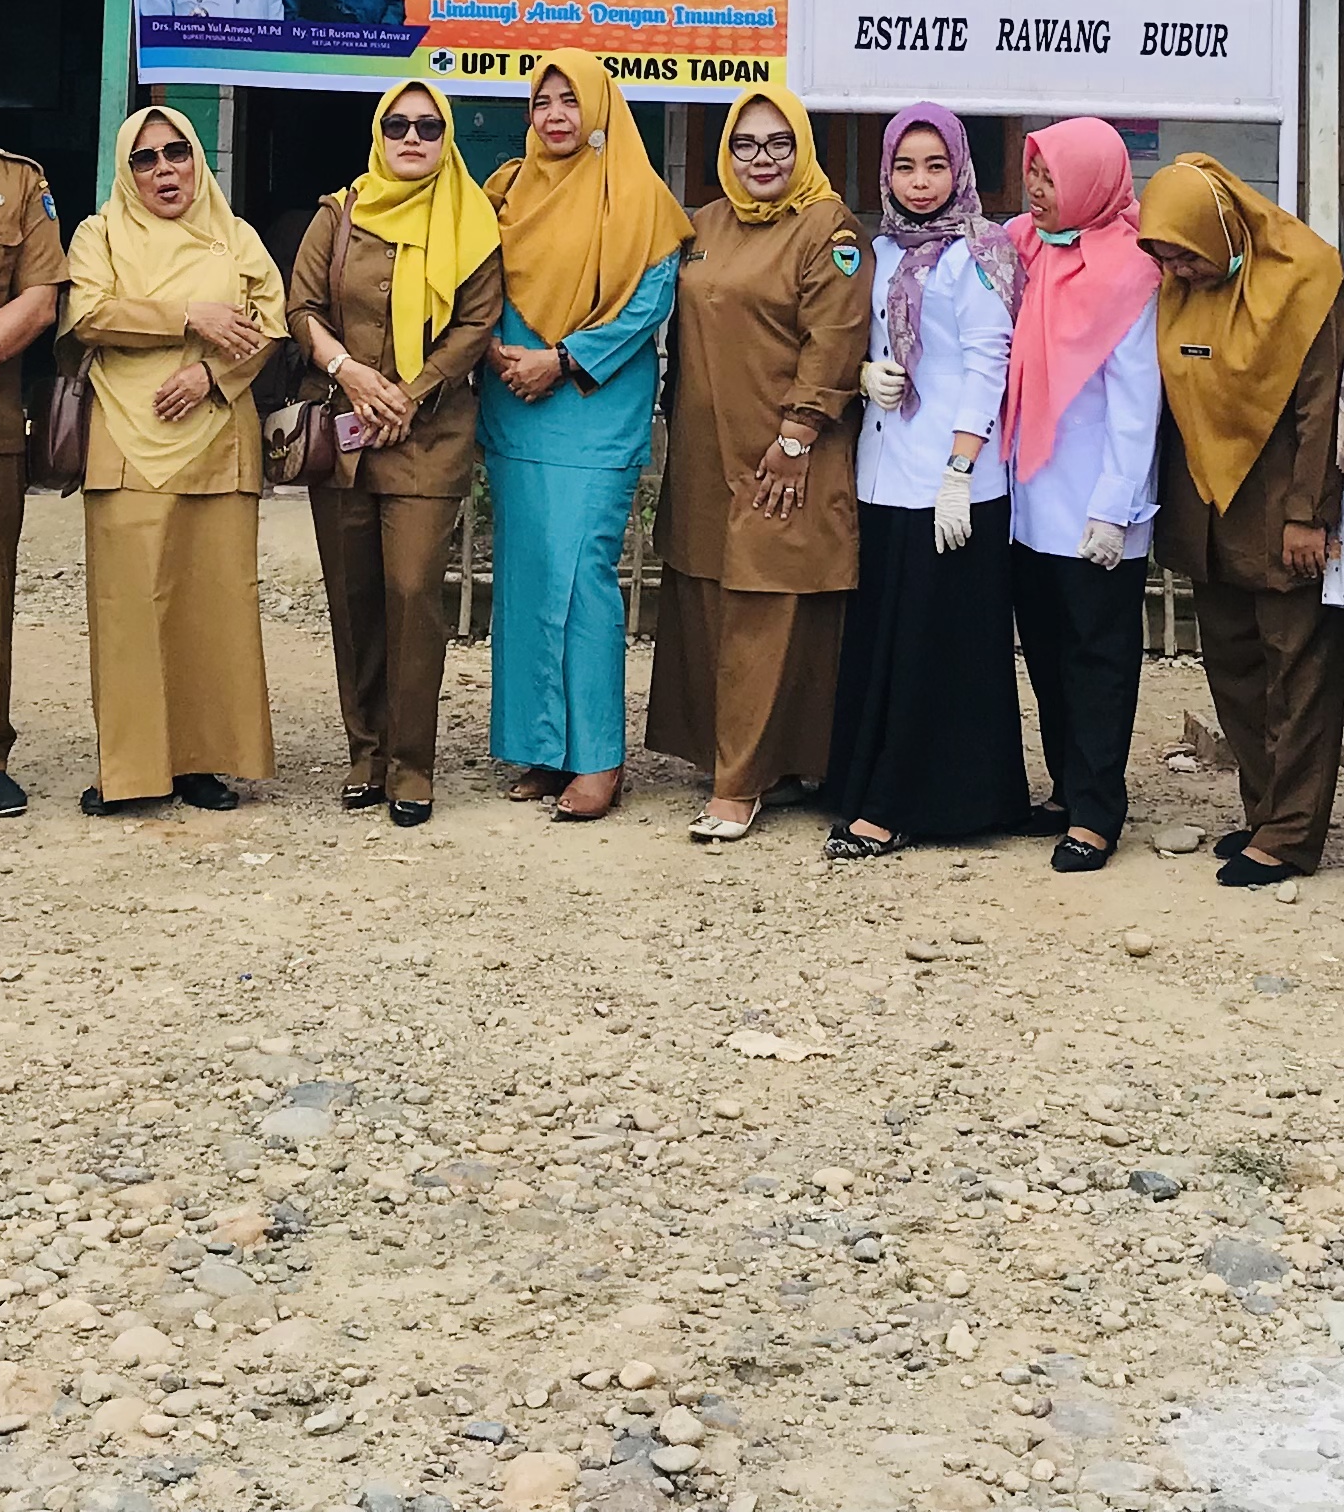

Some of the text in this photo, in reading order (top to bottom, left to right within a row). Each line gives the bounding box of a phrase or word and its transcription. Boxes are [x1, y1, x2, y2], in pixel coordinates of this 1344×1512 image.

[526, 1, 582, 23] Anak
[590, 3, 667, 28] Dengan
[673, 6, 776, 27] Imunisasi
[152, 22, 282, 36] Drs. Rusma Yul Anwar, M.Pd
[292, 28, 411, 41] Ny. Titi Rusma Yul Anwar
[855, 16, 1229, 57] ESTATE RAWANG BUBUR
[461, 52, 770, 83] UPT PSMAS TAPAN
